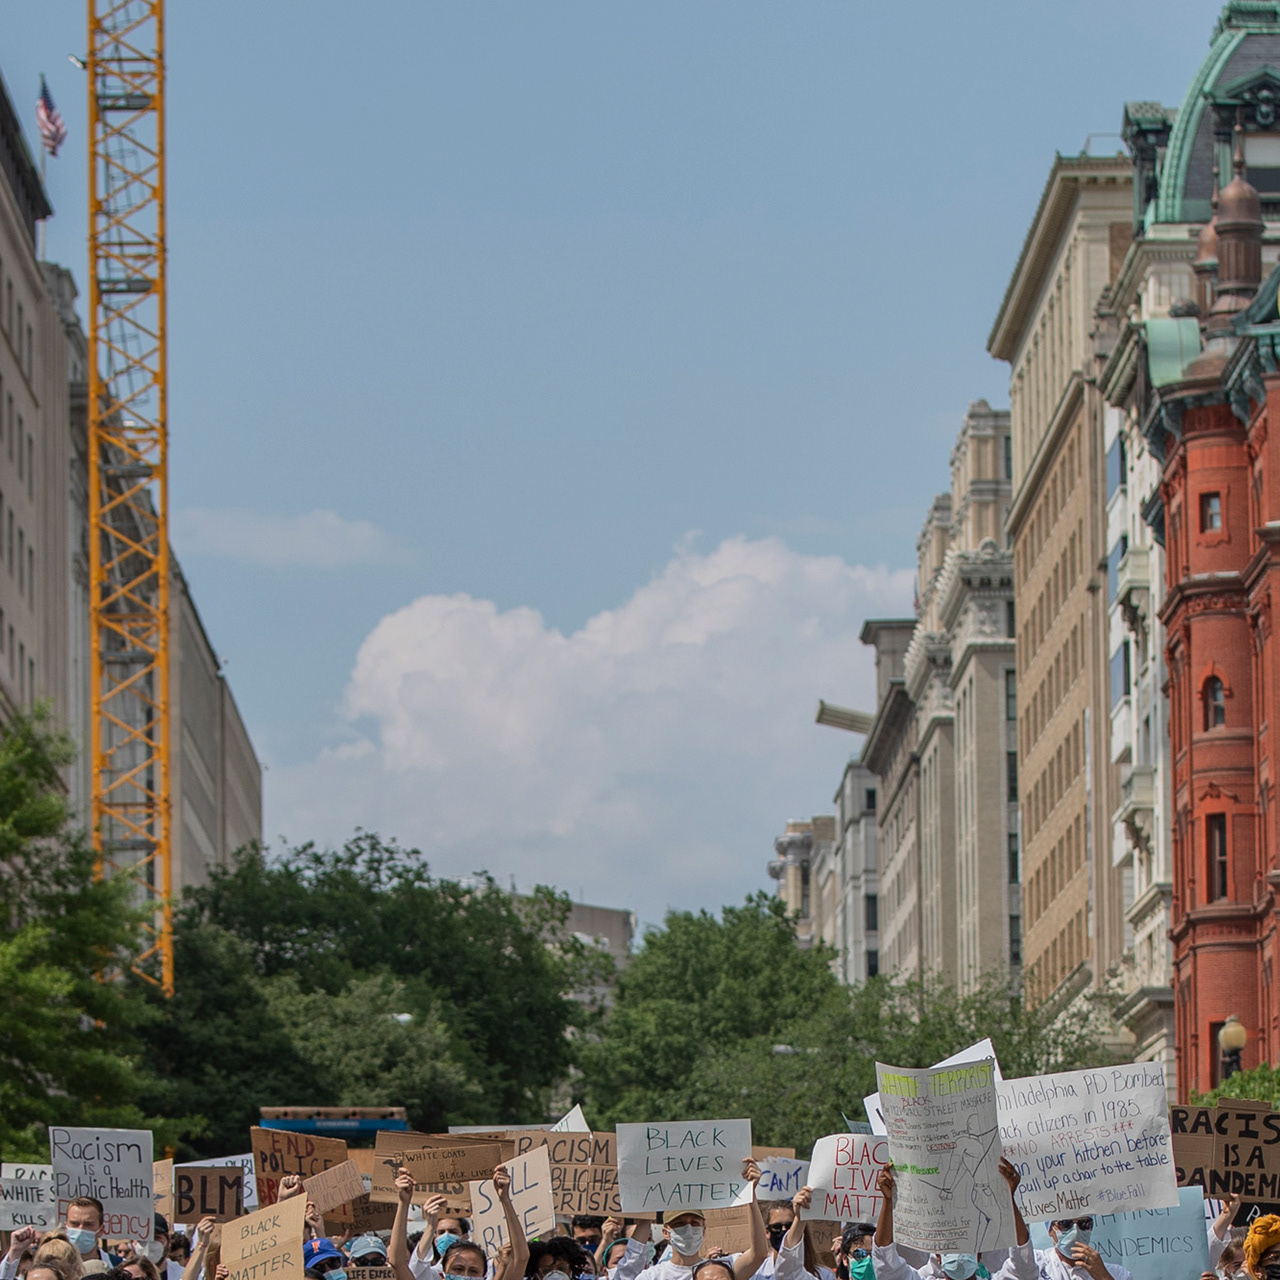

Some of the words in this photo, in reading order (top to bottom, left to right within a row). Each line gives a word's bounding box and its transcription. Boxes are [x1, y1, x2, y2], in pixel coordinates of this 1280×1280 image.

[1083, 1073, 1107, 1095] PD
[1111, 1067, 1165, 1092] Bombed
[1027, 1109, 1078, 1137] citizens
[1084, 1109, 1097, 1124] in
[52, 1128, 142, 1164] Racism
[271, 1132, 315, 1157] END
[647, 1127, 727, 1151] BLACK
[260, 1151, 333, 1176] POLICE
[405, 1153, 437, 1162] WHITE
[442, 1150, 466, 1159] COATS
[645, 1155, 724, 1175] LIVES
[1036, 1152, 1066, 1179] your
[1072, 1140, 1122, 1165] kitchen
[1124, 1128, 1167, 1152] before
[1224, 1144, 1240, 1167] IS
[1245, 1146, 1265, 1168] A
[83, 1161, 95, 1176] is
[103, 1164, 111, 1176] a
[439, 1171, 467, 1181] BLACK
[471, 1168, 494, 1178] LIVES
[757, 1166, 802, 1192] CAN'T
[1018, 1176, 1042, 1198] pull
[1043, 1172, 1059, 1190] up
[1063, 1174, 1072, 1184] a
[1072, 1167, 1097, 1182] chair
[1101, 1162, 1114, 1175] to
[1113, 1158, 1135, 1174] the
[1136, 1151, 1170, 1169] table
[2, 1186, 44, 1203] WHITE
[56, 1172, 106, 1200] Public
[110, 1177, 150, 1199] Health
[177, 1175, 242, 1216] BLM
[642, 1182, 742, 1207] MATTER
[12, 1212, 47, 1226] KILLS
[241, 1214, 281, 1240] BLACK
[241, 1235, 278, 1261] LIVES
[347, 1270, 367, 1280] LIFE
